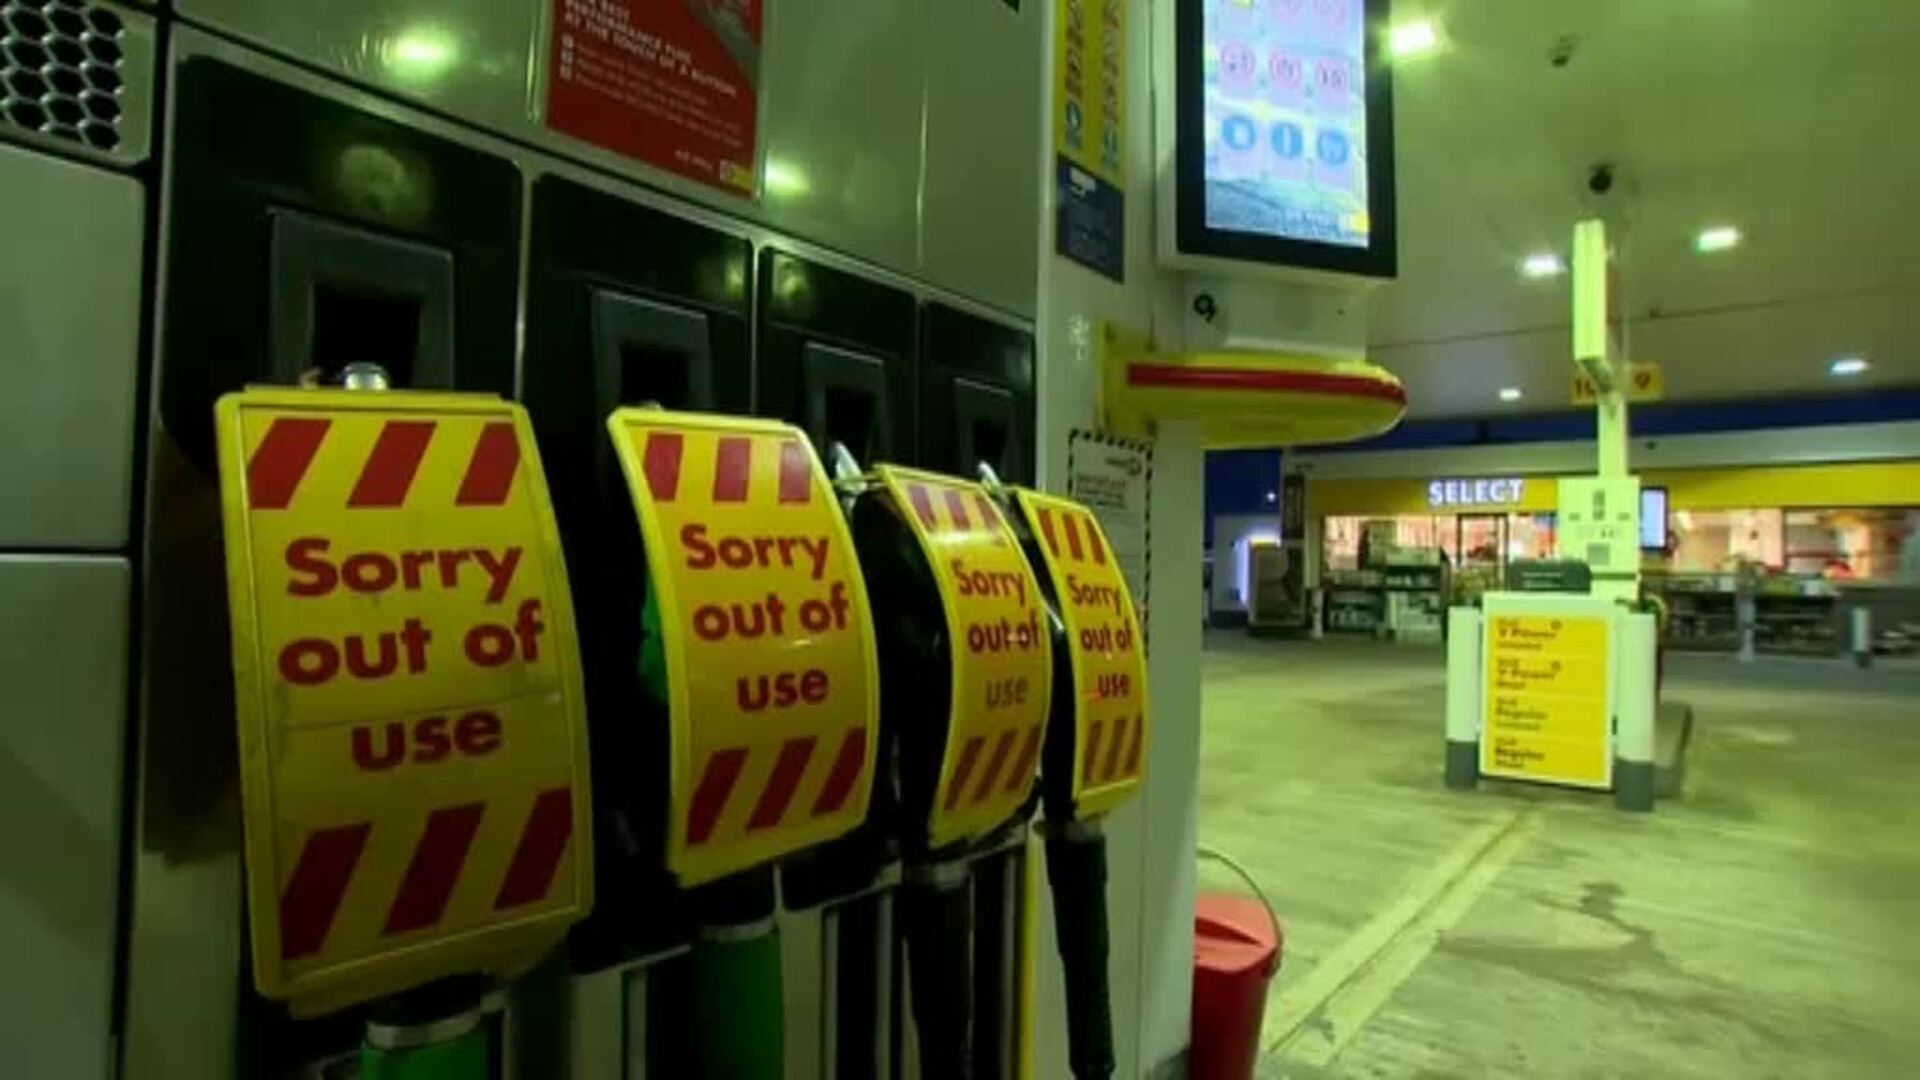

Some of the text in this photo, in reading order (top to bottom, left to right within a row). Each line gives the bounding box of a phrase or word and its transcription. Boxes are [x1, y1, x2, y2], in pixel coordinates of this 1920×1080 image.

[585, 20, 609, 41] THE
[678, 63, 688, 76] A
[1193, 294, 1216, 323] 9
[1428, 478, 1524, 507] SELECT
[284, 537, 522, 605] Sorry
[680, 523, 829, 580] Sorry
[952, 558, 1025, 606] Sorry
[1067, 574, 1120, 616] Sorry
[692, 580, 848, 641] out of
[968, 609, 1039, 653] out of
[278, 598, 544, 686] out of
[1080, 618, 1133, 655] out of
[736, 669, 829, 713] use
[986, 677, 1028, 709] use
[1097, 674, 1130, 699] use
[351, 710, 503, 771] use
